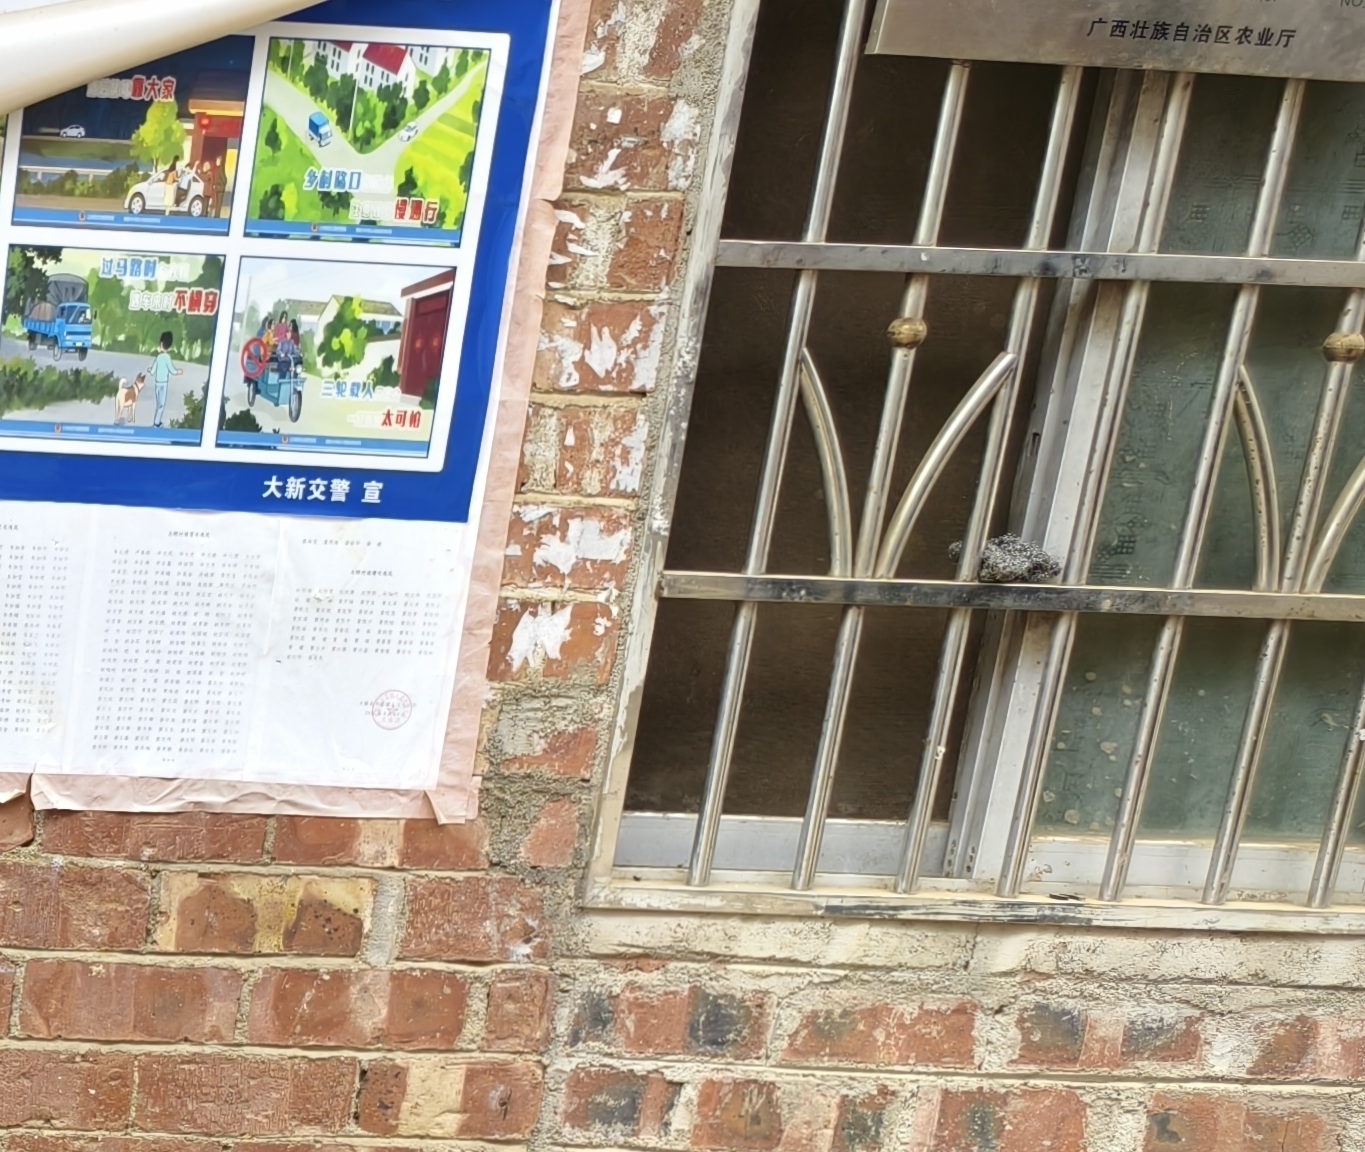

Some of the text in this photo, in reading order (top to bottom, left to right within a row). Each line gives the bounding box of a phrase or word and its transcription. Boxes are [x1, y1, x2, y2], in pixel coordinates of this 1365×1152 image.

[1086, 18, 1297, 48] 广西壮族自治区农业厅
[262, 475, 383, 503] 大新交警 宣
